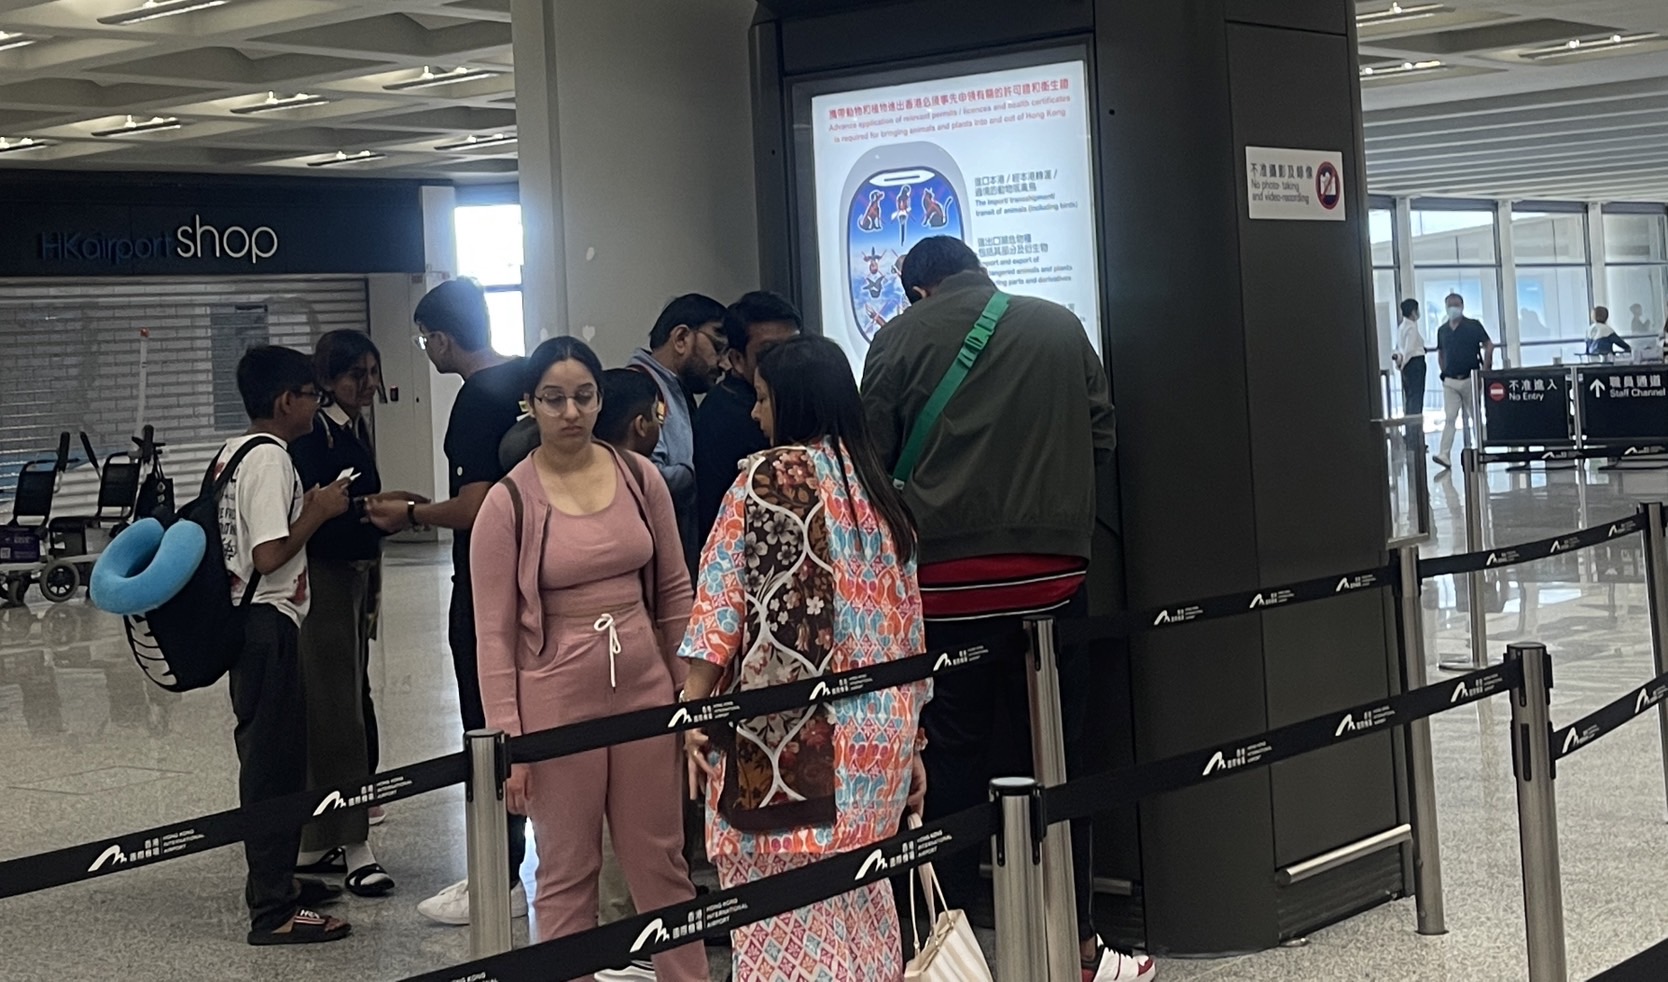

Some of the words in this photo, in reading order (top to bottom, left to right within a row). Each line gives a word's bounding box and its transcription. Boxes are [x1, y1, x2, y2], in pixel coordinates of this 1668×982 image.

[993, 102, 1006, 110] and
[1031, 95, 1070, 106] certificates
[841, 131, 868, 142] required
[937, 122, 950, 131] and
[989, 115, 1002, 124] and
[1026, 111, 1045, 120] Hong
[1046, 109, 1066, 118] Kong
[1251, 179, 1261, 189] No
[1252, 191, 1263, 201] and
[177, 214, 278, 264] shop
[1523, 392, 1545, 401] Entry
[1609, 388, 1629, 398] Staff
[1631, 388, 1666, 397] Channel
